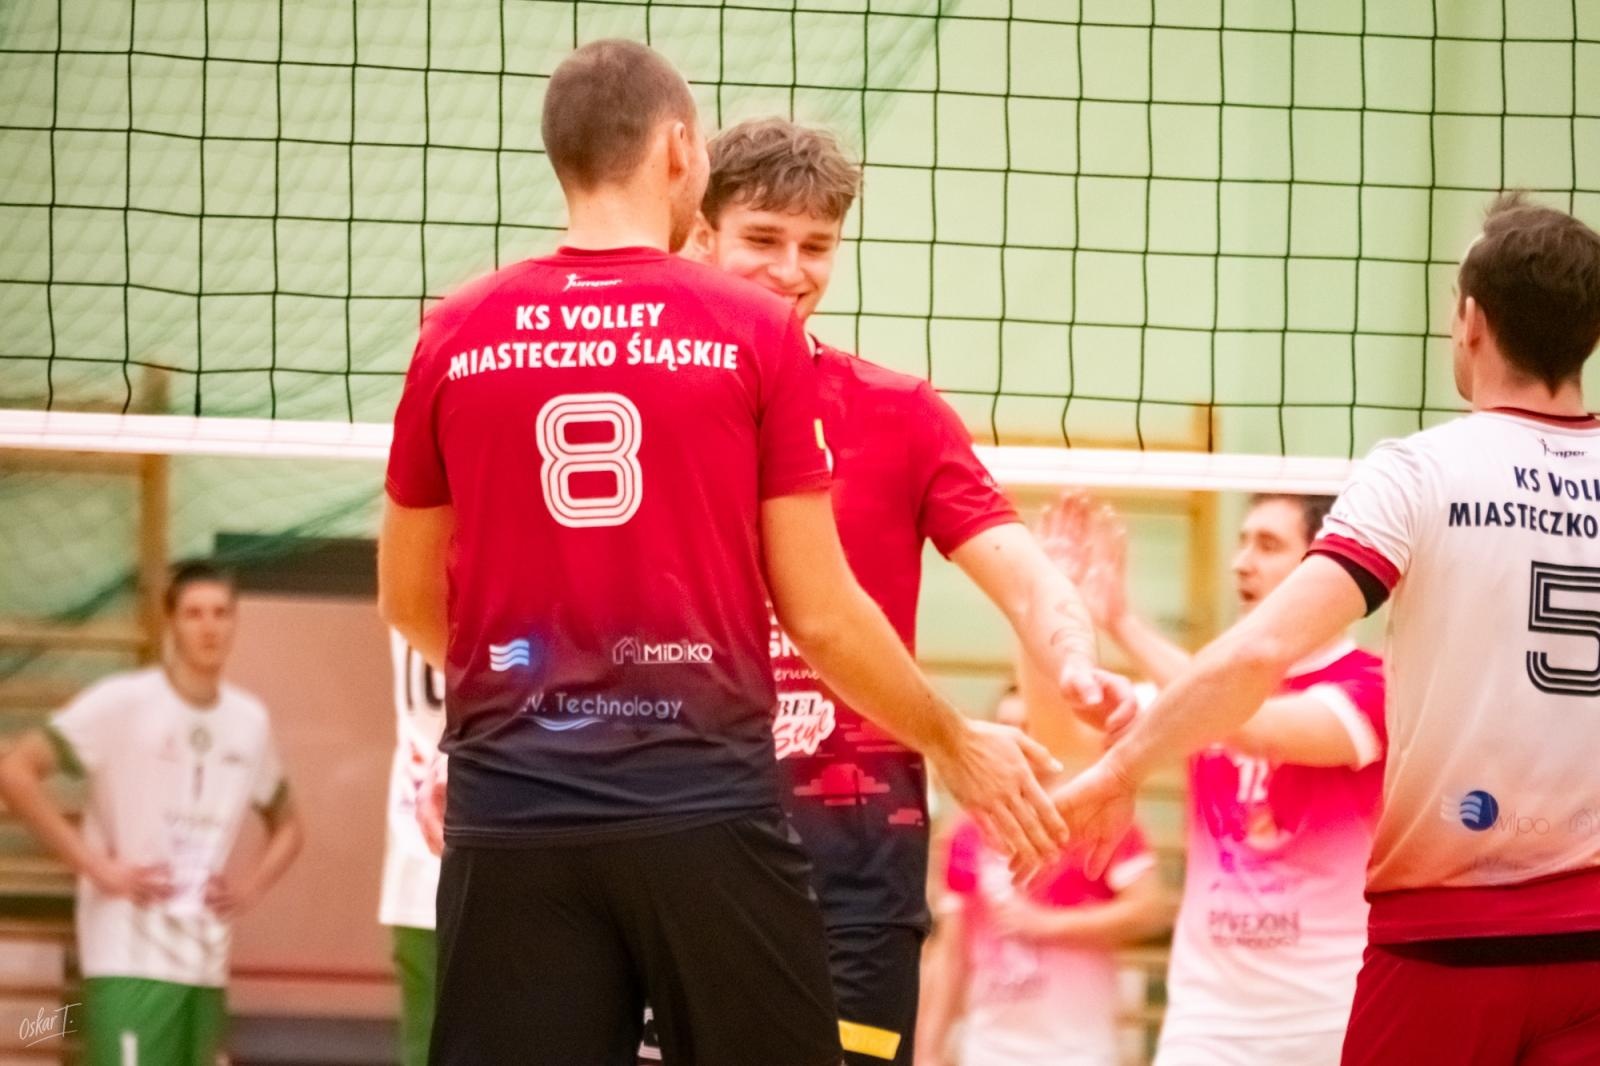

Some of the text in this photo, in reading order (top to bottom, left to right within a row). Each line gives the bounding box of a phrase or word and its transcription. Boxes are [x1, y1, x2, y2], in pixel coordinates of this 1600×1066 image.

[516, 303, 665, 331] KS VOLLEY
[448, 332, 739, 381] MIASTECZKO ŚLĄSKIE
[536, 392, 643, 528] 8
[1513, 465, 1541, 493] KS
[1448, 502, 1599, 539] MIASTECZKO
[1526, 560, 1600, 698] 5
[554, 692, 683, 719] Technology
